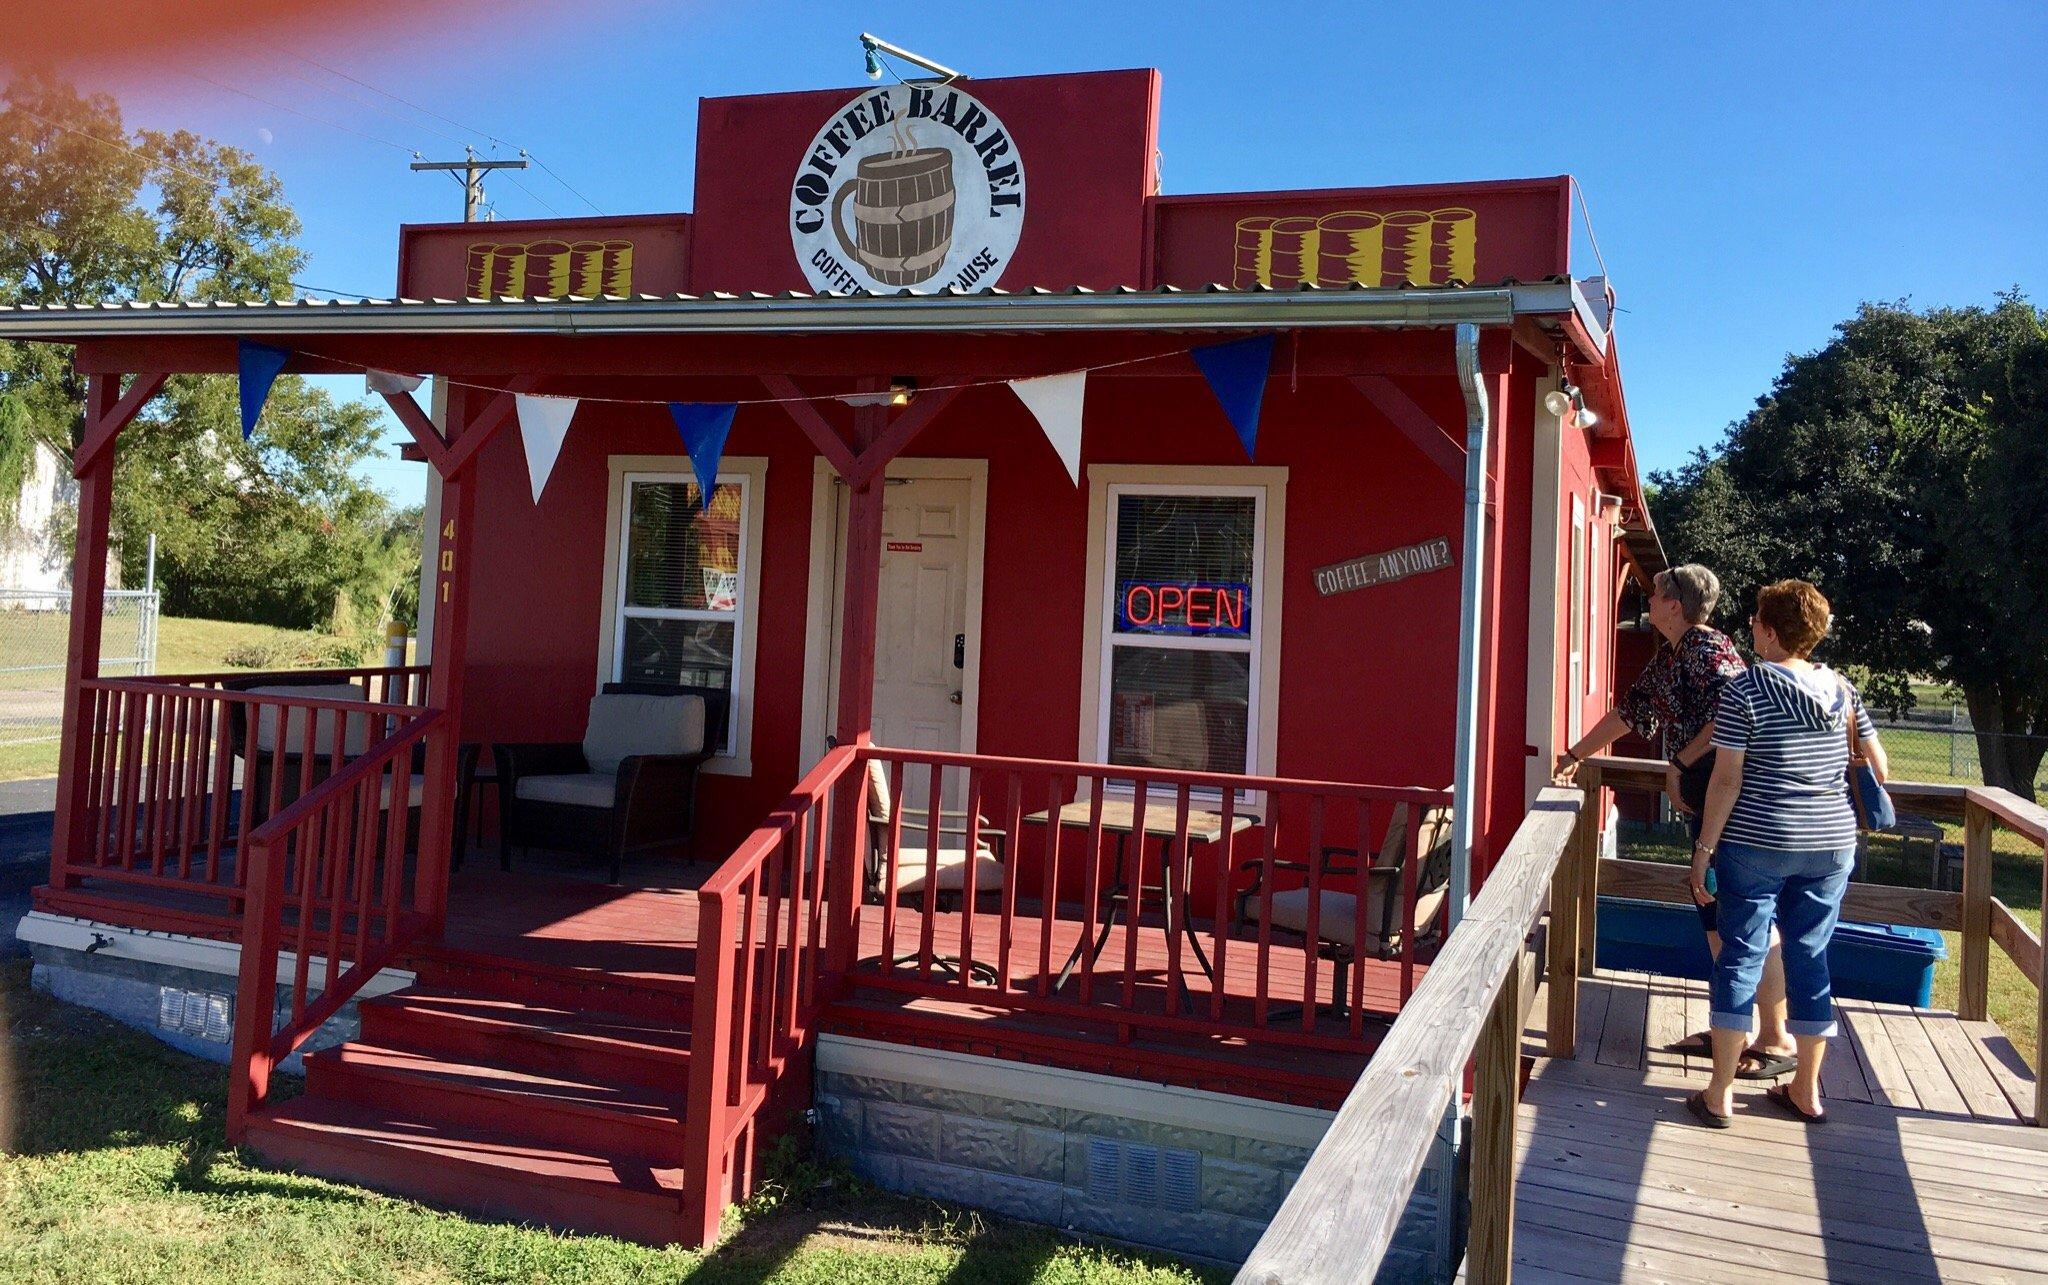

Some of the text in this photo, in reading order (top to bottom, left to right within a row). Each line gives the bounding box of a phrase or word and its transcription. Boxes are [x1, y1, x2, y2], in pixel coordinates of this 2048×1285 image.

[795, 85, 1021, 234] COFFEE BARREL
[441, 519, 455, 603] 401
[1379, 541, 1448, 579] ANYONE?
[1127, 585, 1244, 629] OPEN
